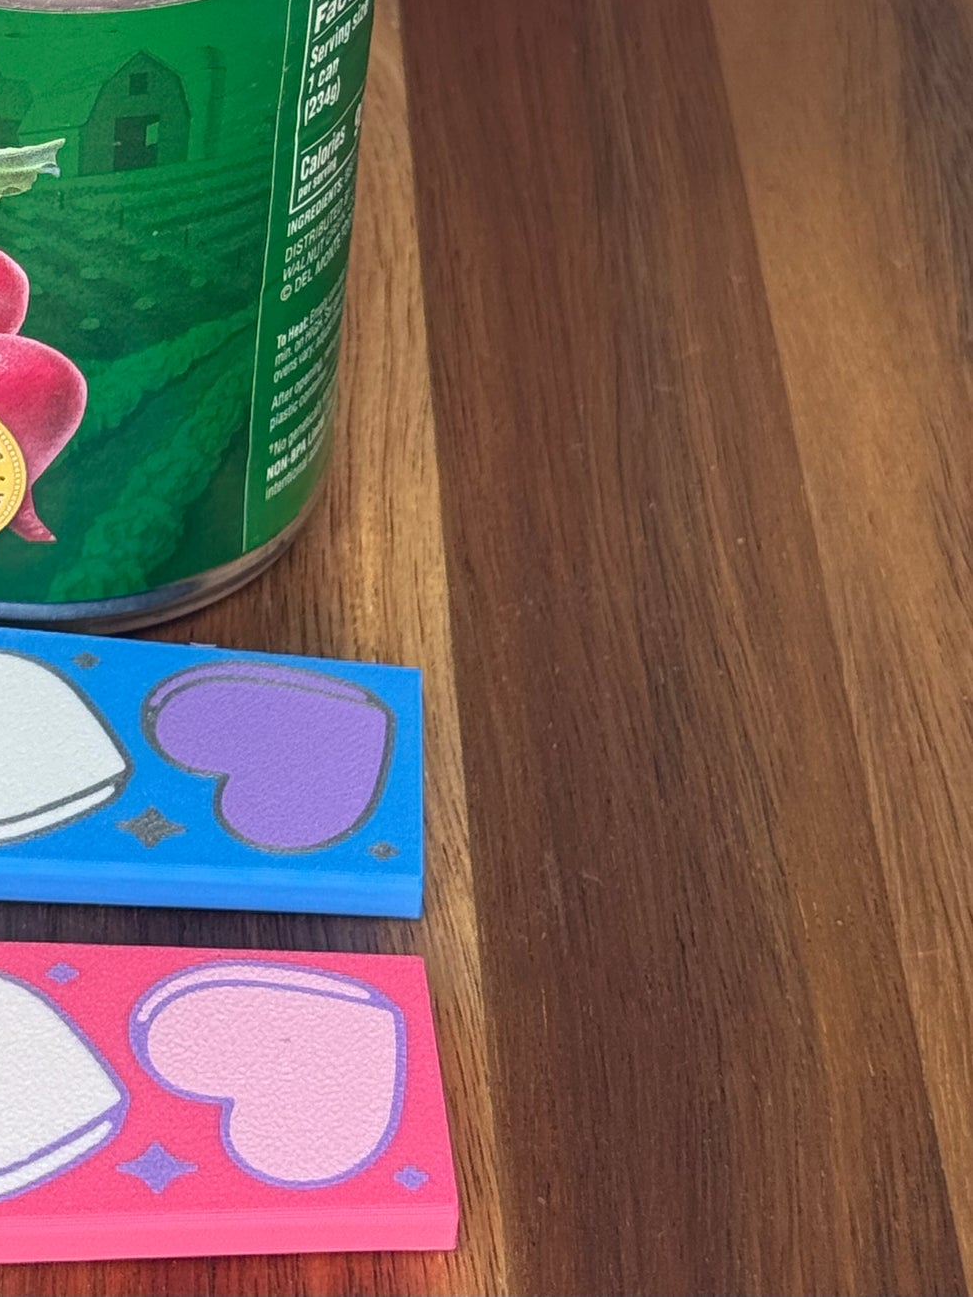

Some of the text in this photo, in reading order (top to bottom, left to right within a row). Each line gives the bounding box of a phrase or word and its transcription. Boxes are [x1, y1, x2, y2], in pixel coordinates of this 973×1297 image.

[309, 20, 352, 69] Serving
[308, 57, 340, 94] 1 can
[304, 75, 341, 127] (234g)
[300, 125, 346, 182] Calories
[283, 237, 325, 282] WALNUT
[294, 268, 313, 294] DEL
